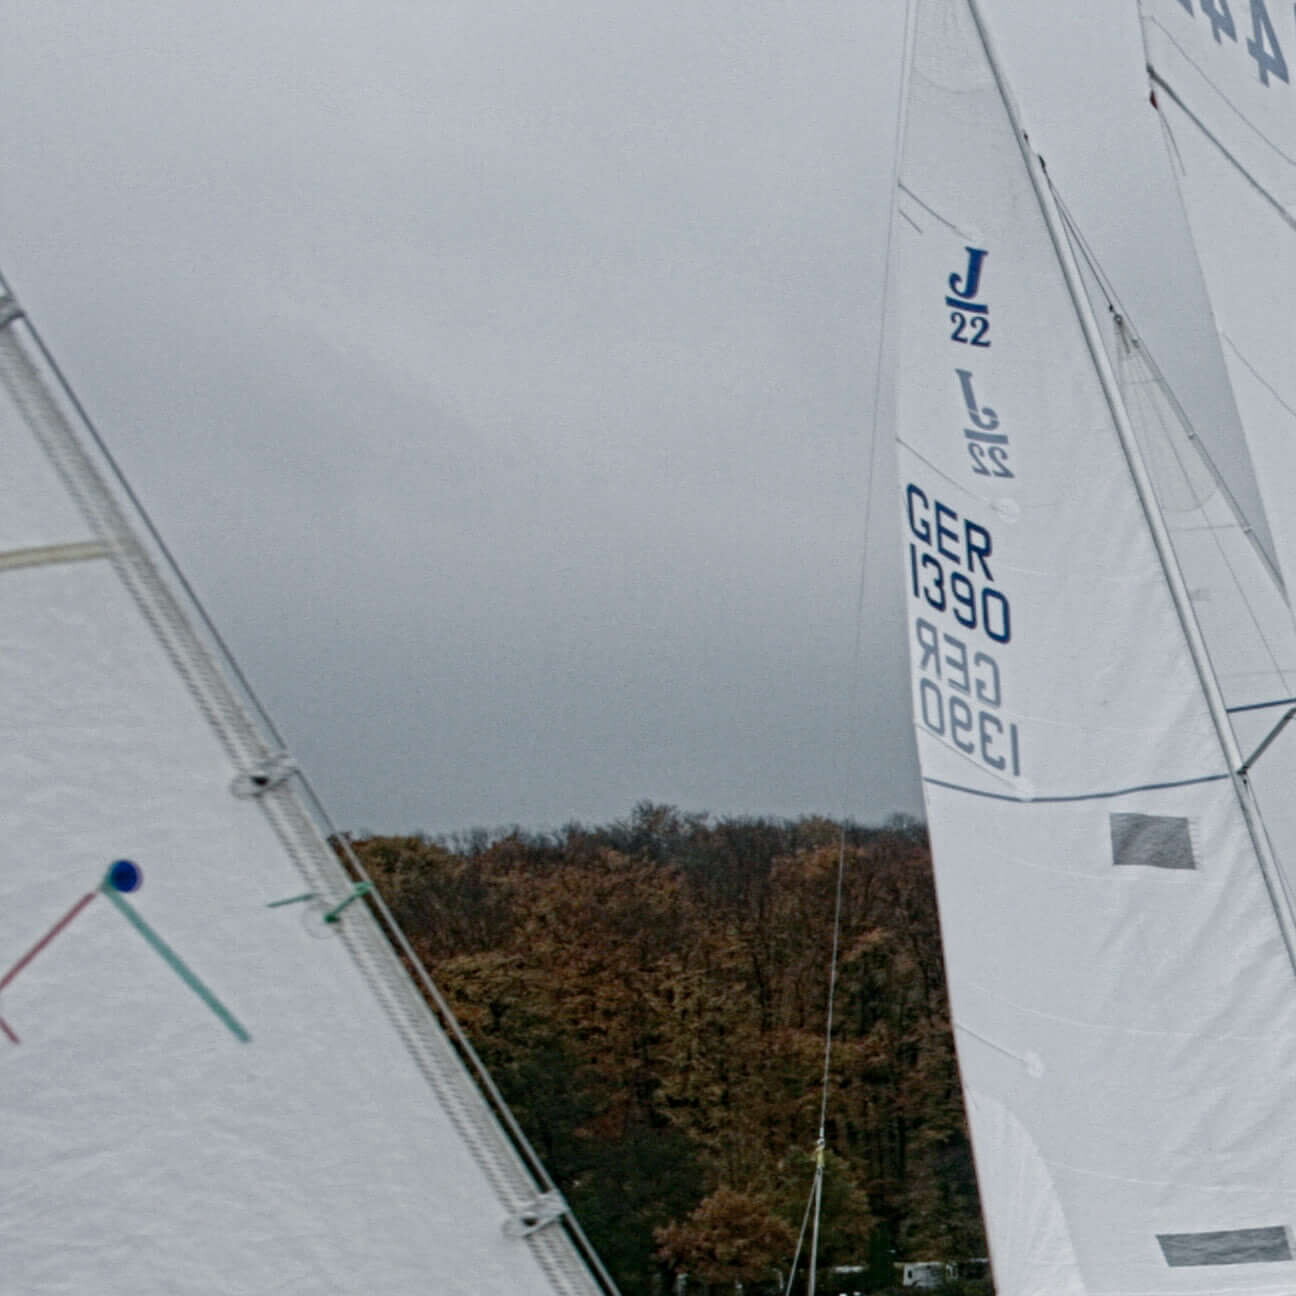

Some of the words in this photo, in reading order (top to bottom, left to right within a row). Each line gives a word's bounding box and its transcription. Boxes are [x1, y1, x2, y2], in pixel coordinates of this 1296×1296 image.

[945, 246, 989, 300] J
[950, 311, 992, 348] 22
[904, 482, 994, 584] GER
[909, 542, 1013, 645] 1390
